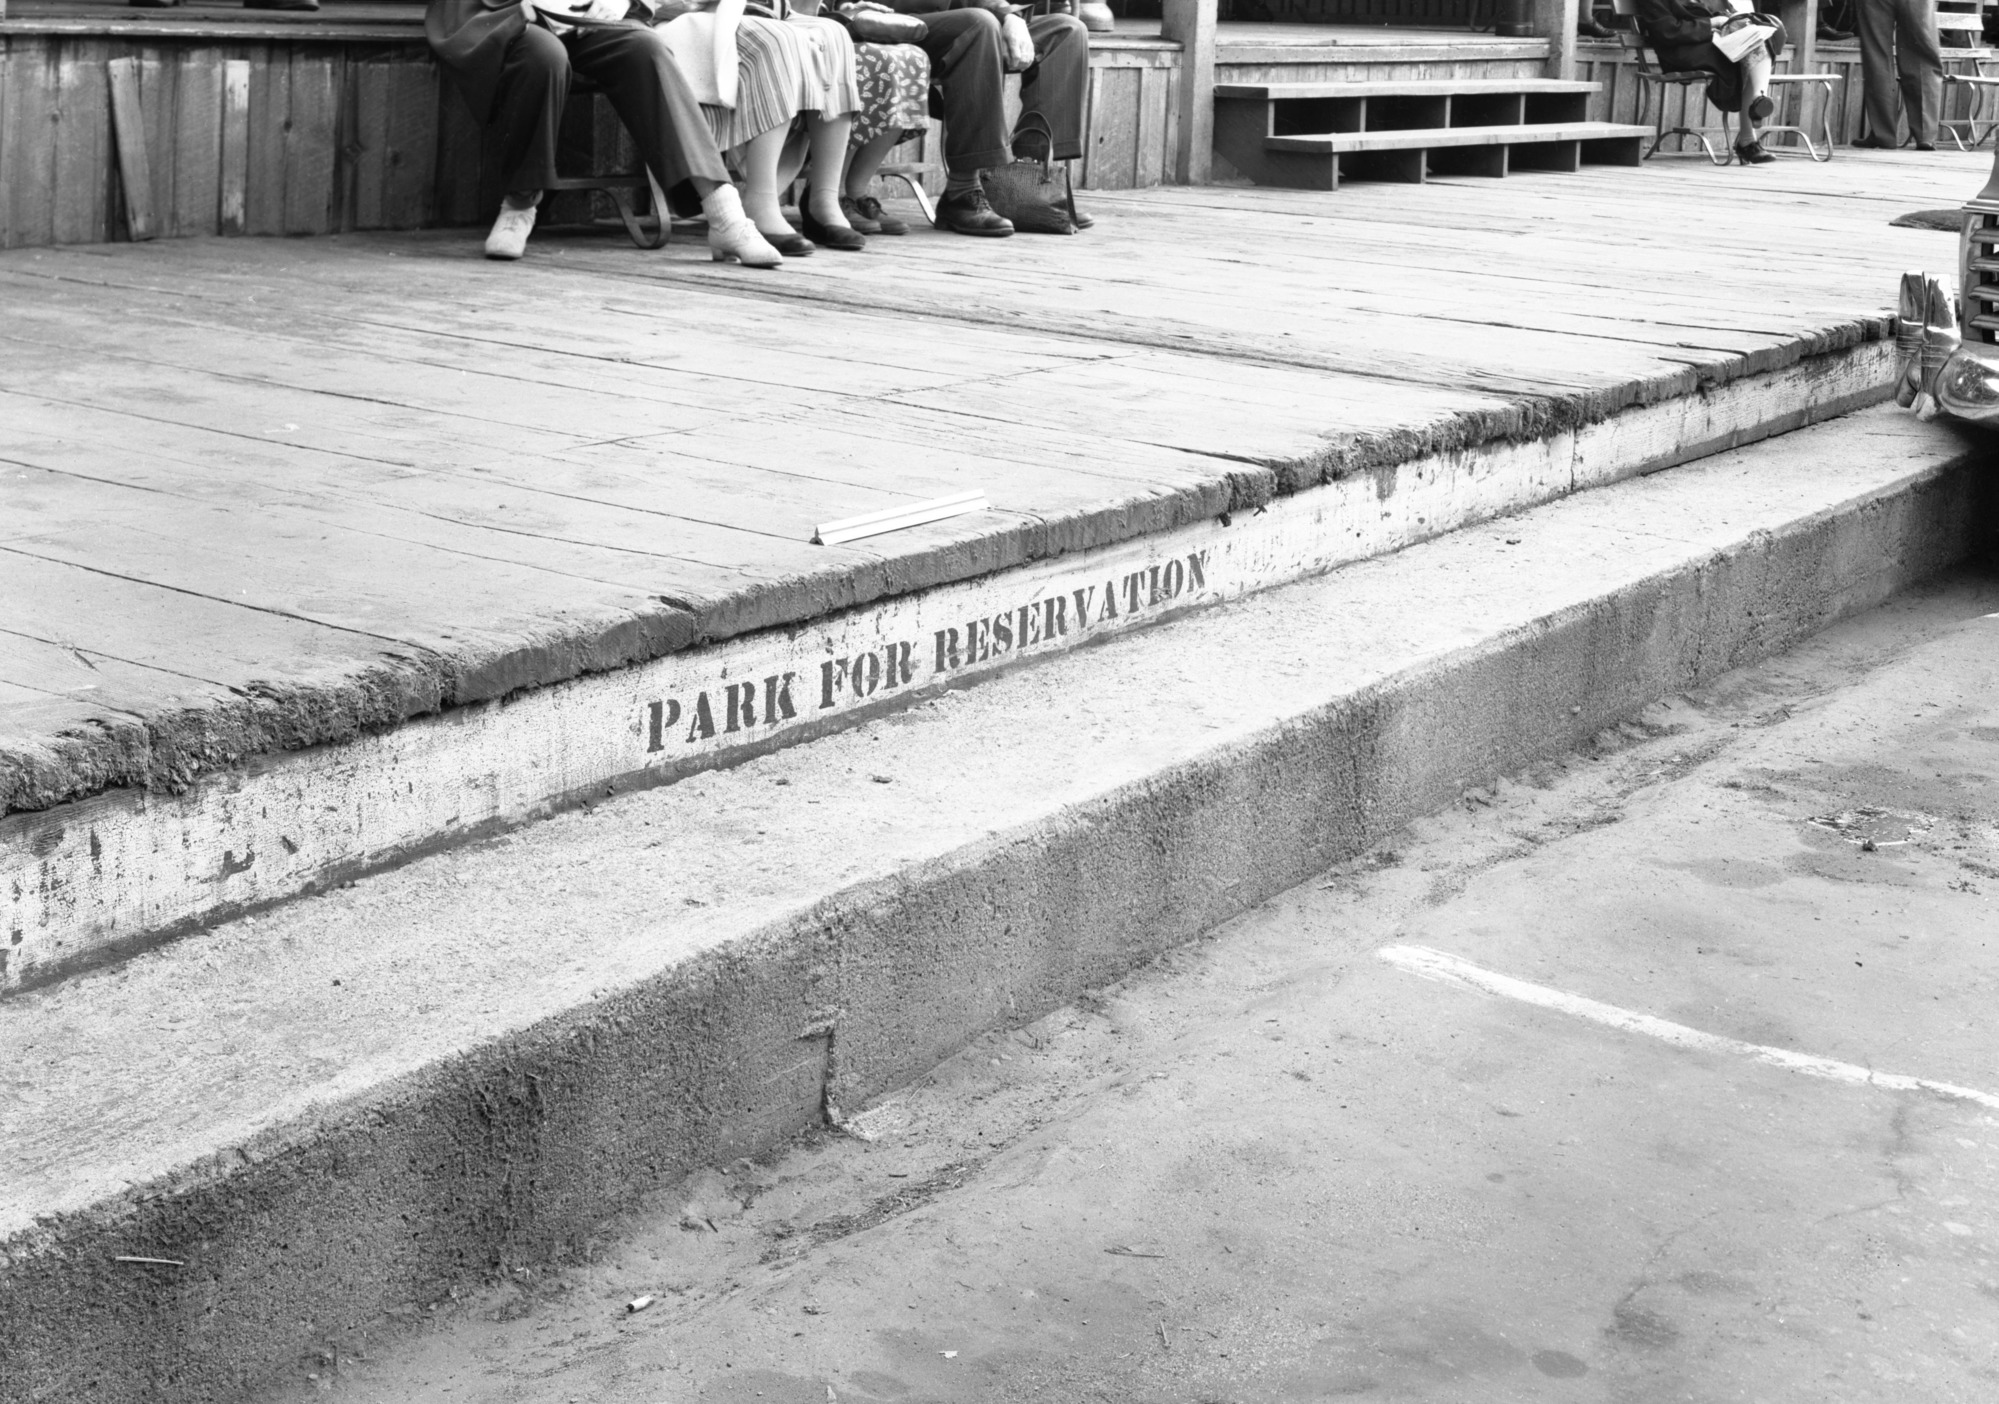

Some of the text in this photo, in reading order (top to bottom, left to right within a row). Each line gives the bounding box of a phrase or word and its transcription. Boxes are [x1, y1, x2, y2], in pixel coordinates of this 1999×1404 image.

[647, 549, 1207, 753] PARK FOR RESERVATION
